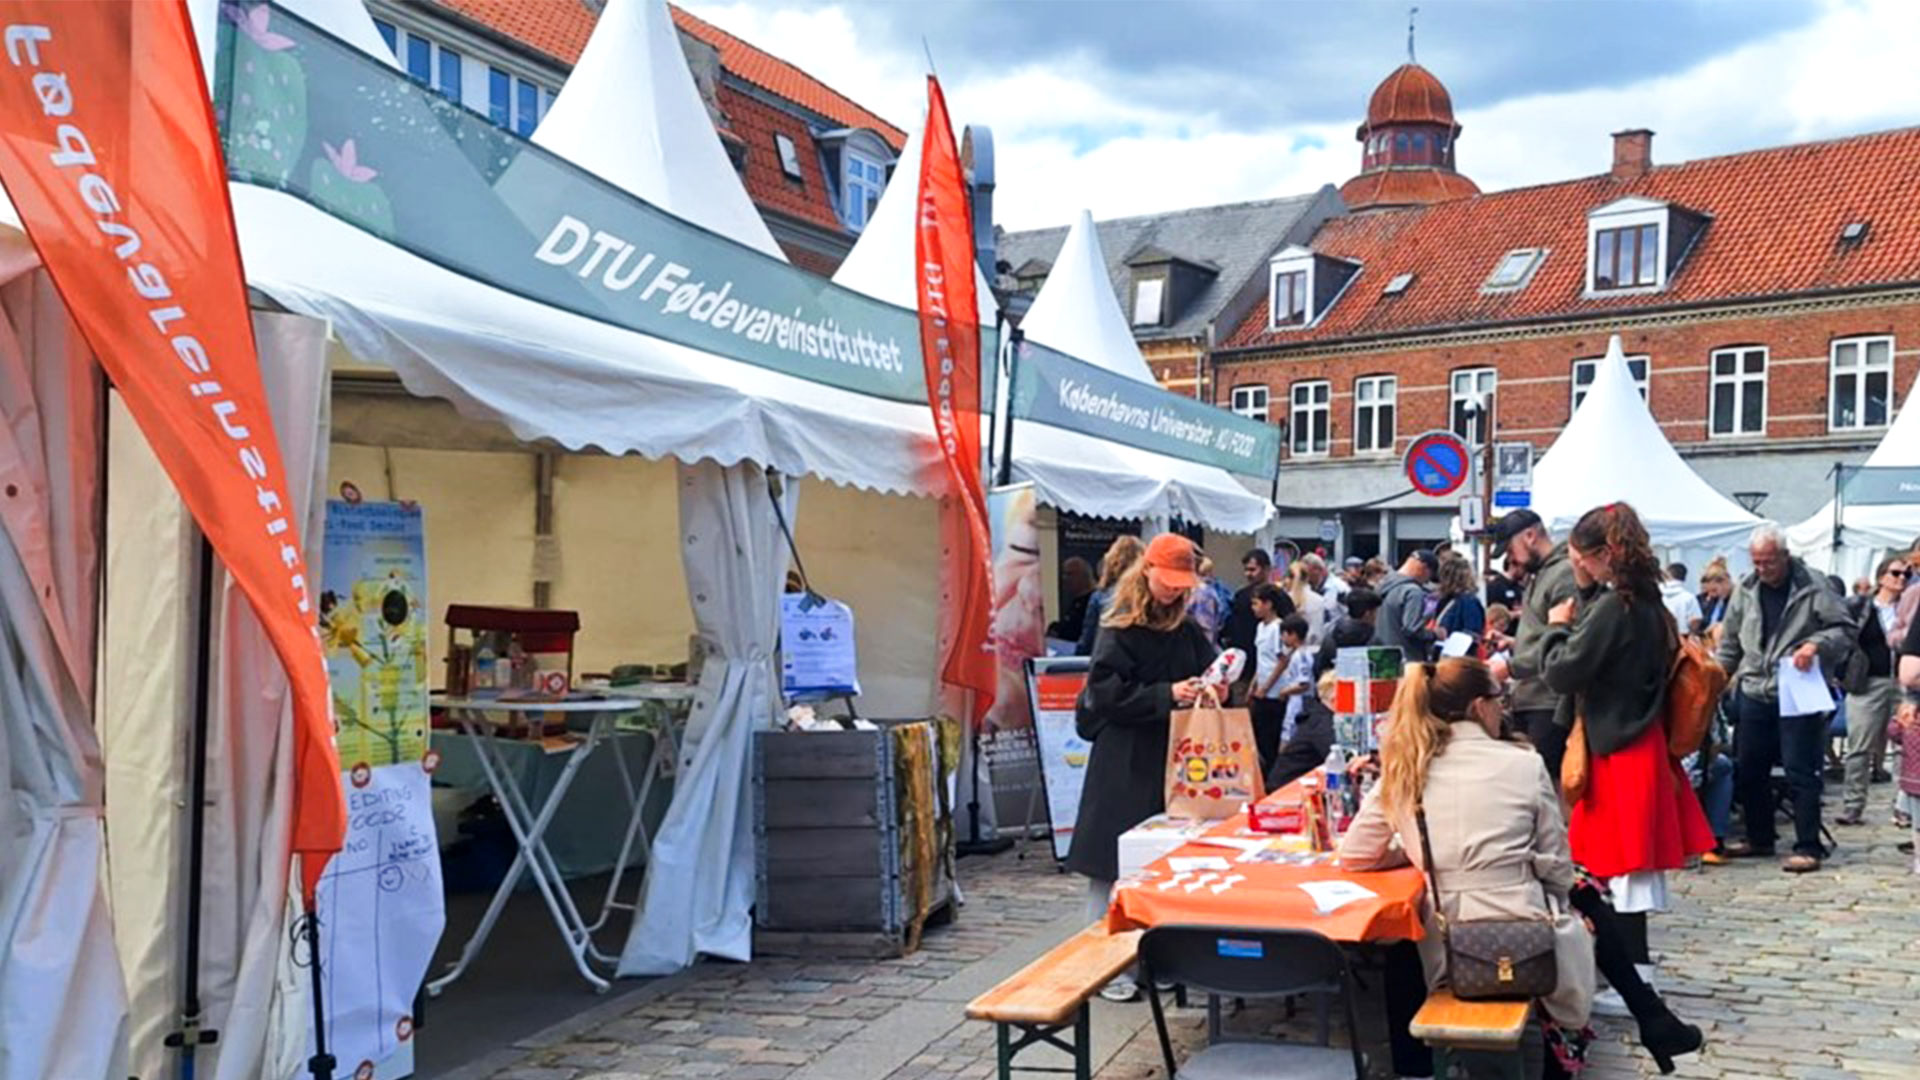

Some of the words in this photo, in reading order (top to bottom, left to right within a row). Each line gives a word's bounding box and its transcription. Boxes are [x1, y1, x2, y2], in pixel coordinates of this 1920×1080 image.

[534, 214, 655, 291] DTU
[639, 261, 904, 373] Fødevareinstituttet
[1058, 377, 1151, 430] Københavns
[1150, 406, 1214, 447] Universitet
